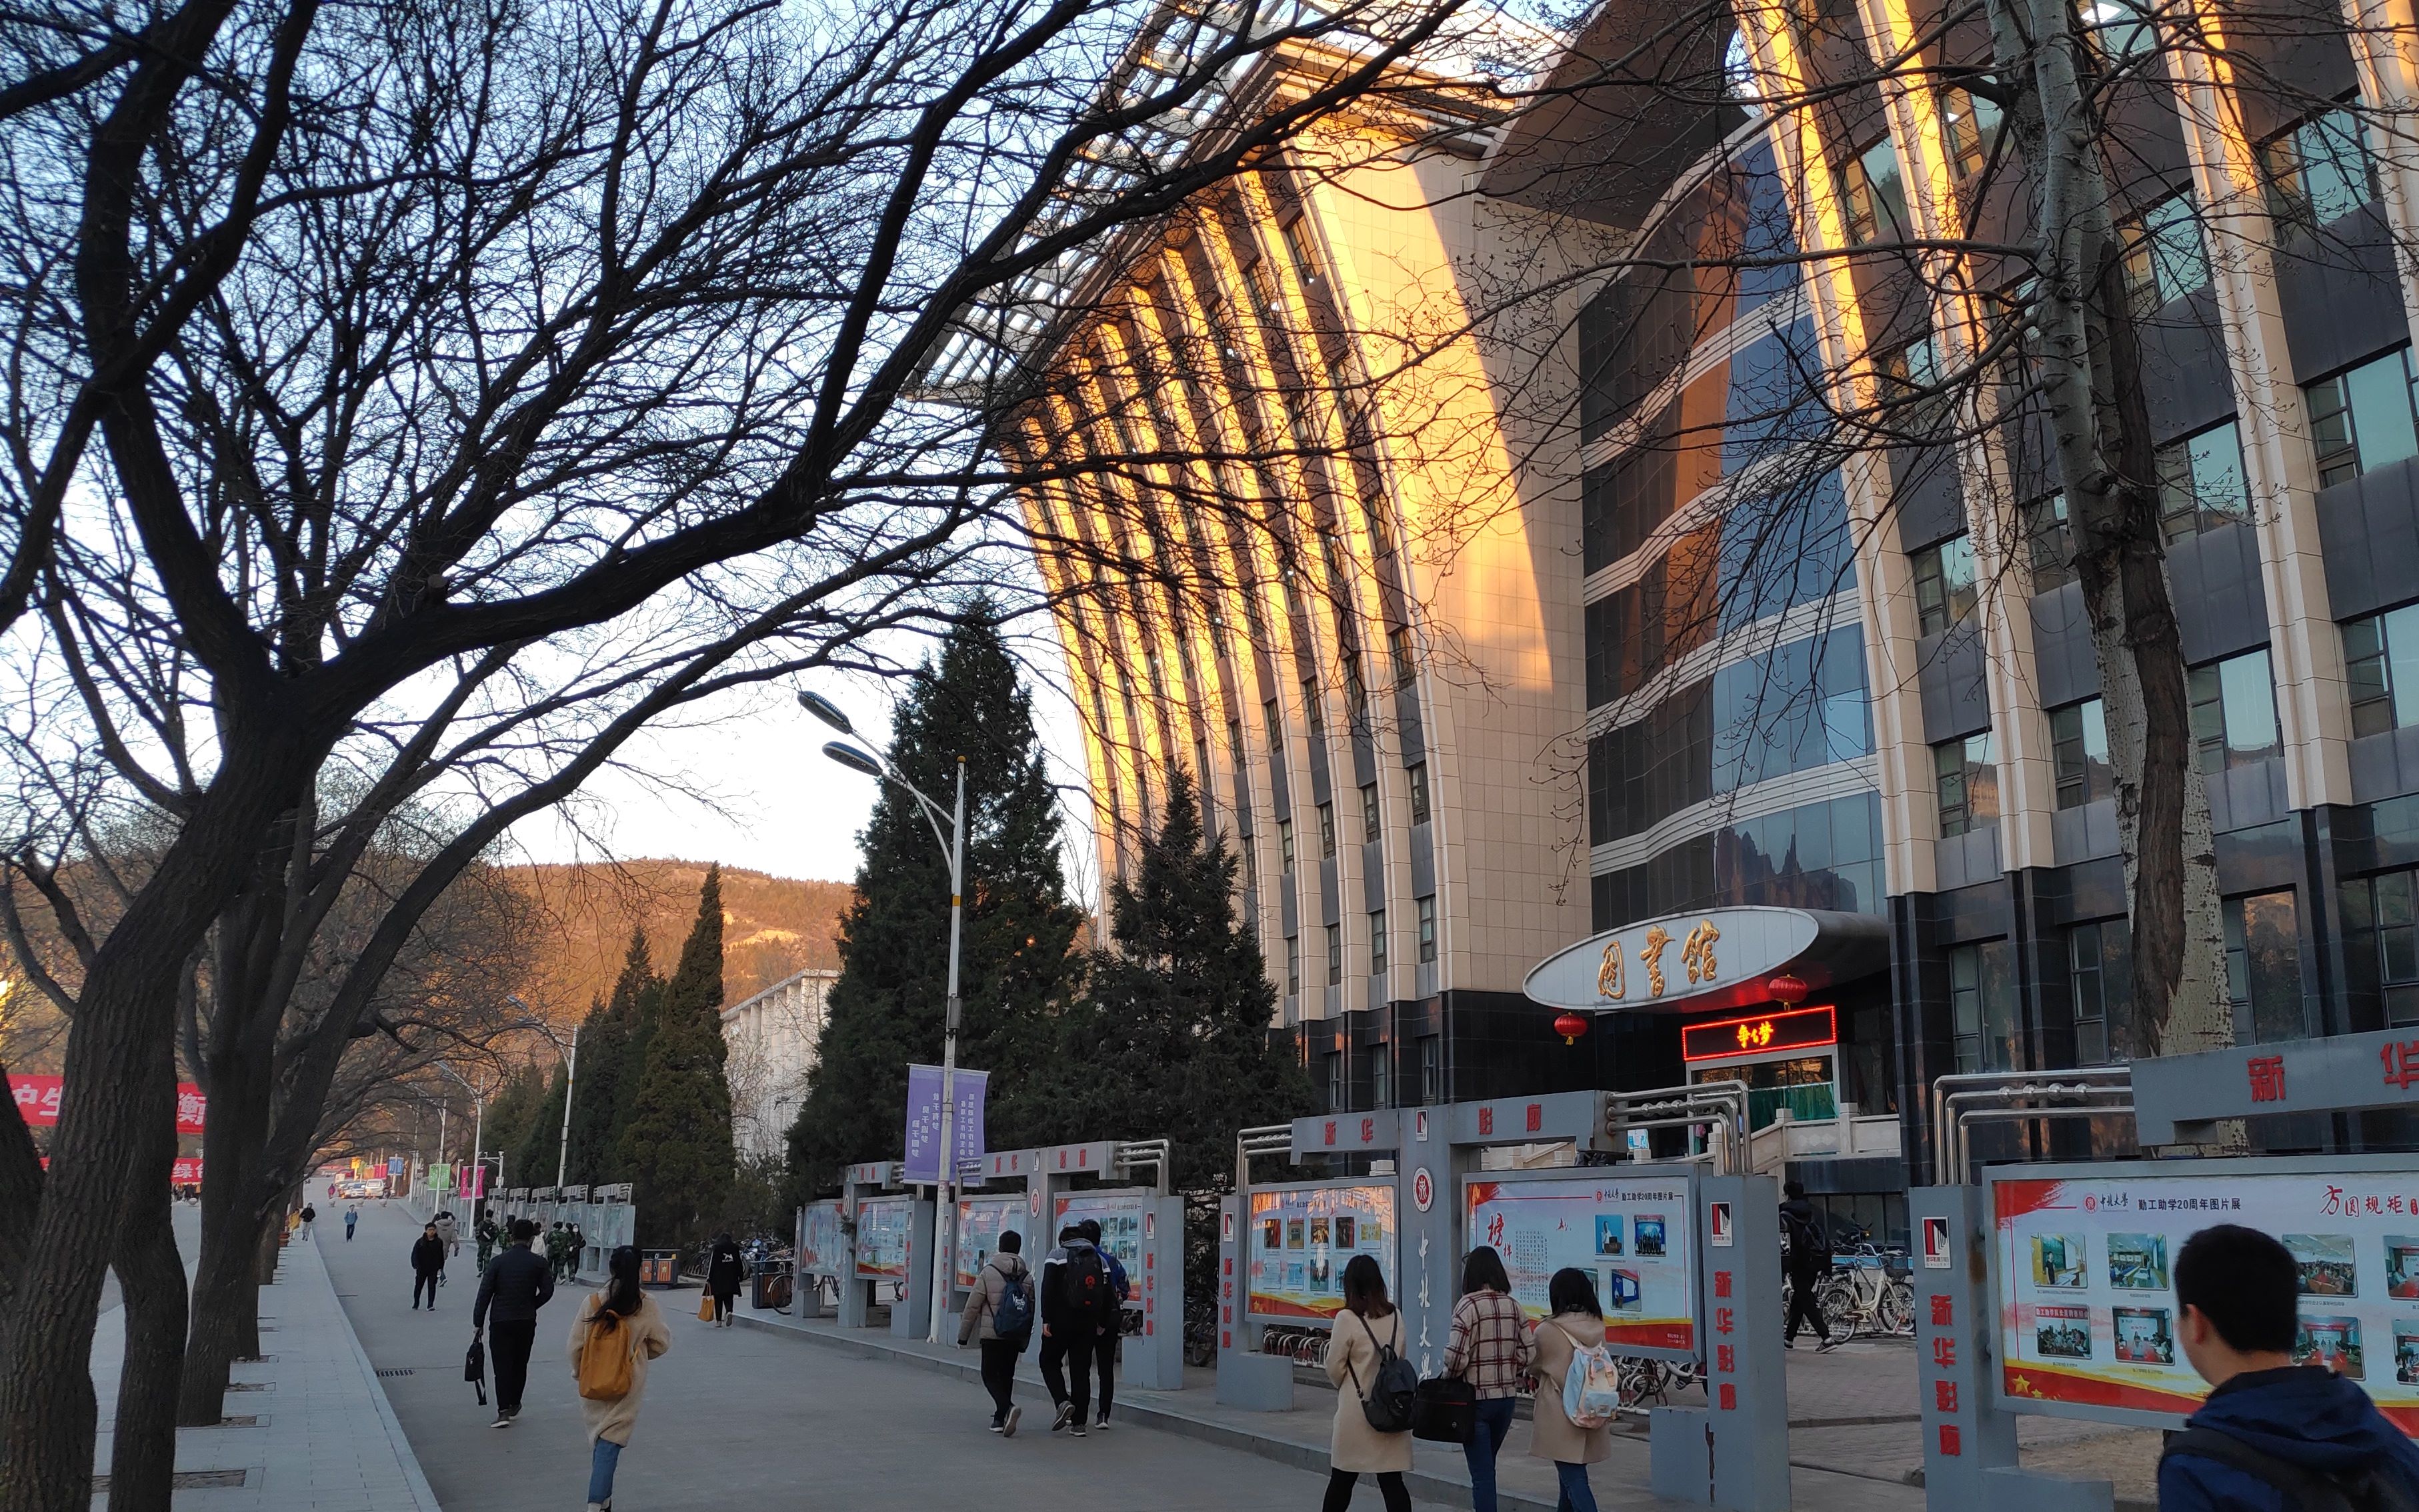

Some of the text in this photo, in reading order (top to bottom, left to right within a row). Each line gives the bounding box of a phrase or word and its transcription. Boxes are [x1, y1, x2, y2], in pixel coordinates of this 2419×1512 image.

[2138, 1197, 2241, 1211] 勤工助学20周年图片展
[2320, 1185, 2404, 1217] 方圆规矩
[1714, 1271, 1736, 1411] 新华影廊
[1930, 1294, 1962, 1456] 新华影廊
